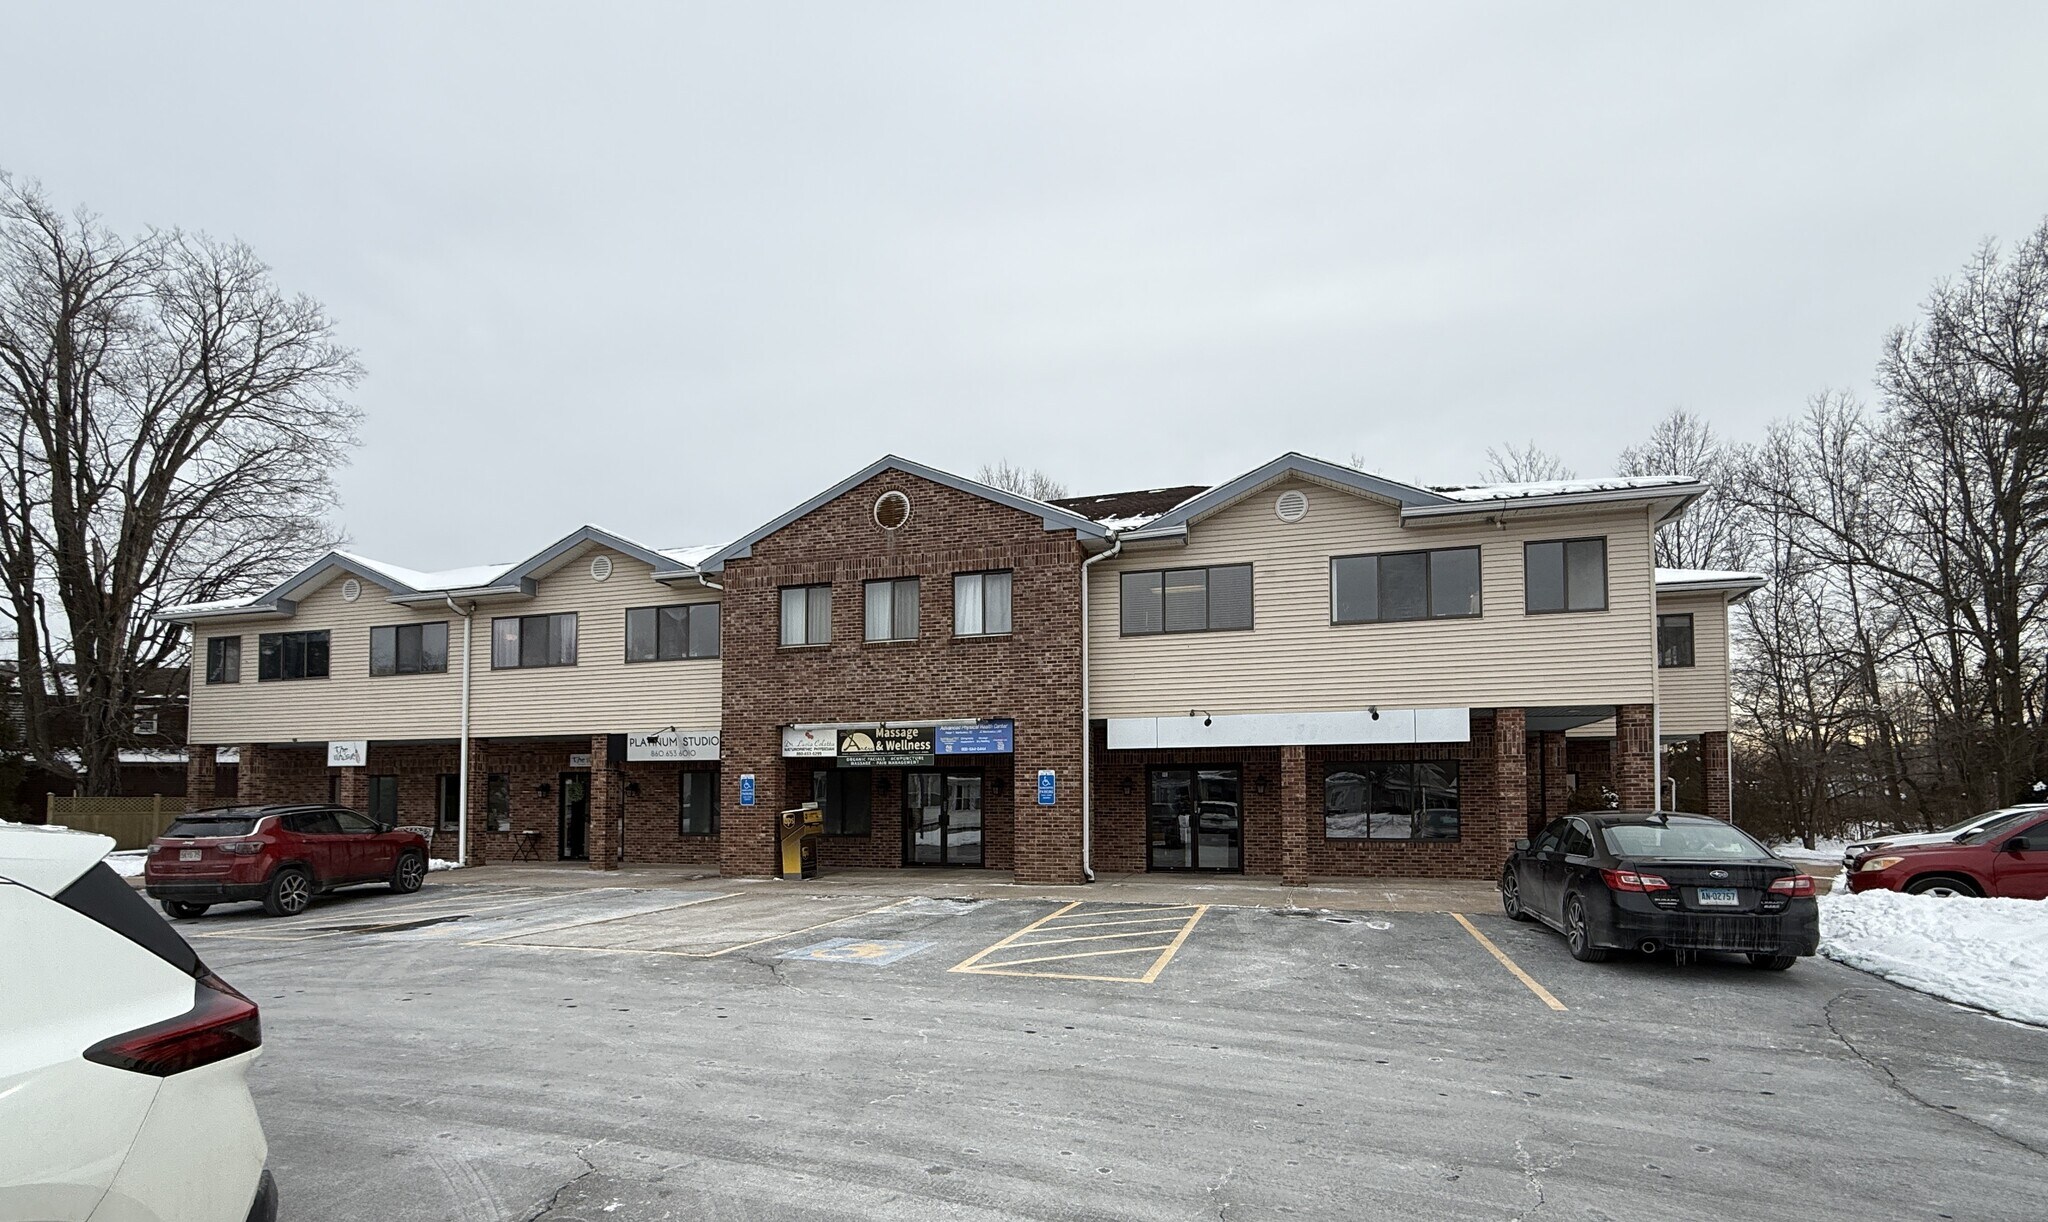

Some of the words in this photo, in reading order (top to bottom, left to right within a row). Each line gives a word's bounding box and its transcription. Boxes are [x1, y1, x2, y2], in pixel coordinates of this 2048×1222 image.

[875, 728, 919, 740] Massage
[682, 736, 720, 747] STUDIO
[876, 740, 884, 751] &
[886, 739, 931, 750] Wellness
[650, 749, 664, 758] 860
[665, 749, 677, 757] 653
[678, 749, 697, 757] 6010
